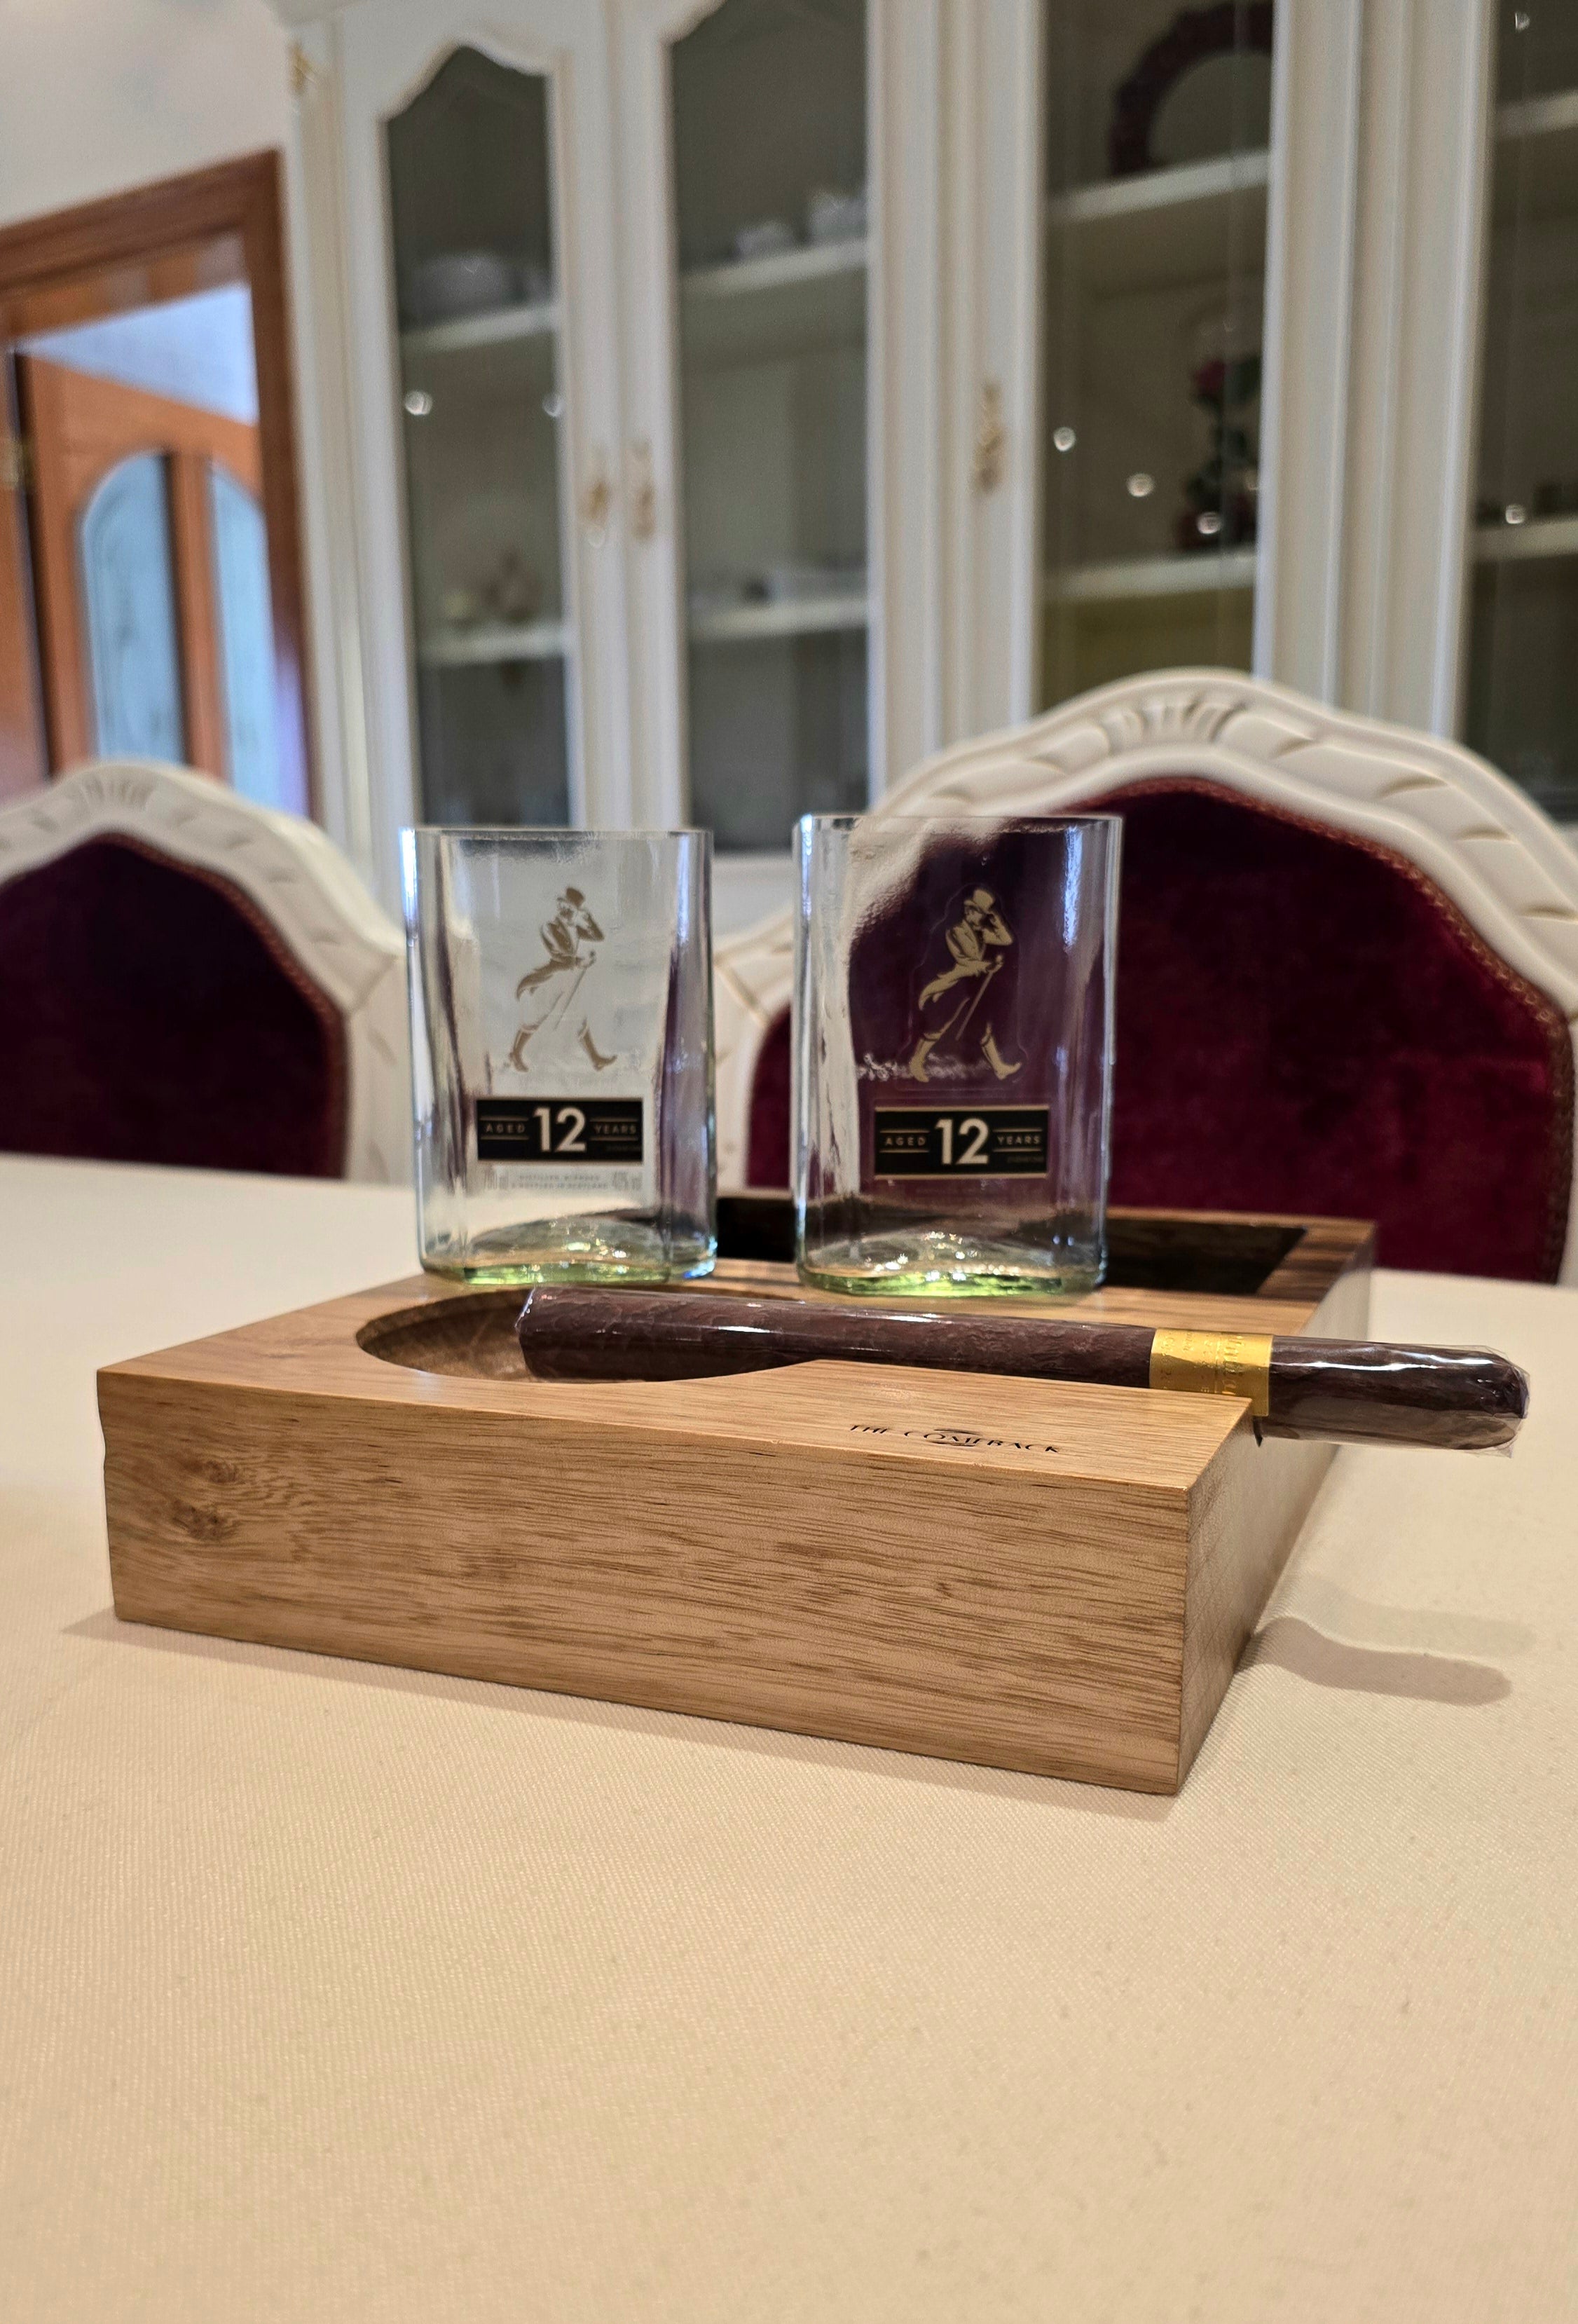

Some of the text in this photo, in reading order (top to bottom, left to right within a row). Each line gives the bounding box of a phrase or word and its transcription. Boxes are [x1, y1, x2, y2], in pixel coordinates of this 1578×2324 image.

[485, 1107, 637, 1153] AGED 12 YEARS
[884, 1118, 1041, 1165] AGED 12 YEARS
[850, 1424, 1059, 1454] THE COMEBACK
